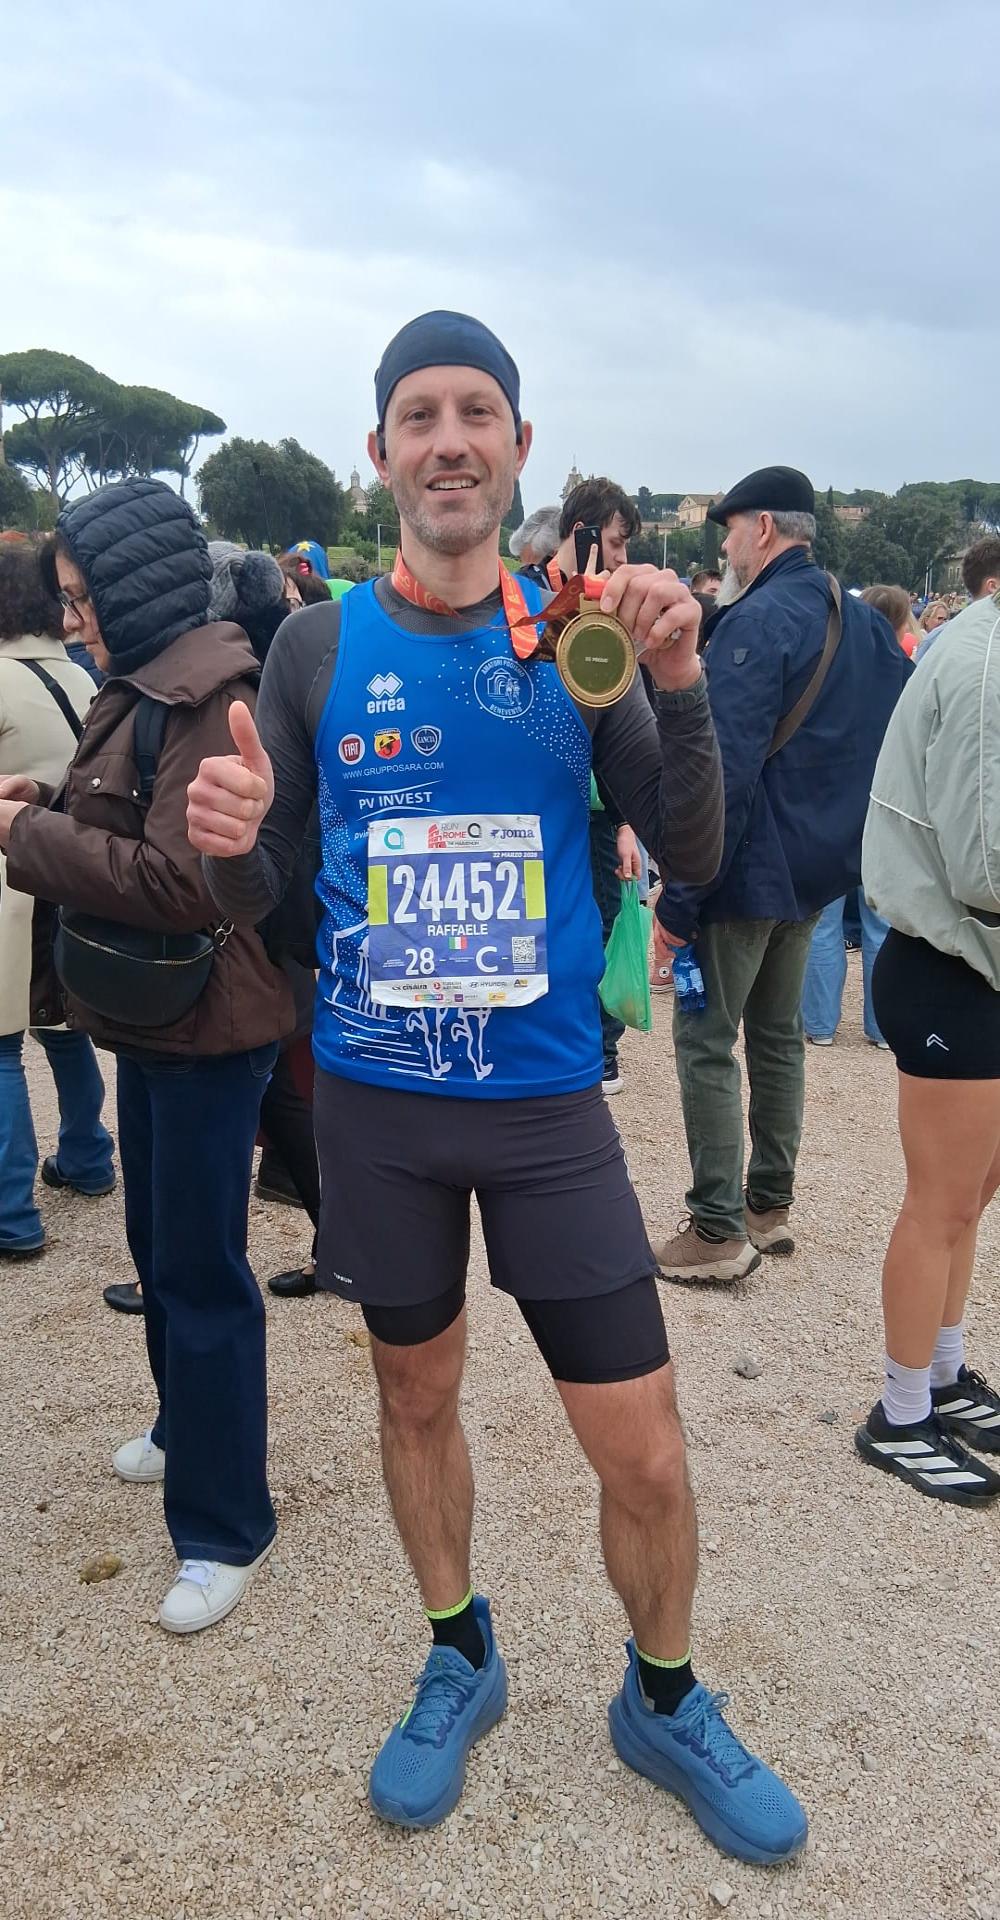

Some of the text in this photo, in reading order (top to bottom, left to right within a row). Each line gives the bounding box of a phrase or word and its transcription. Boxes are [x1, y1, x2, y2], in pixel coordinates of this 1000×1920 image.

[366, 698, 406, 714] errea
[490, 703, 522, 716] BENEVENTO
[417, 736, 436, 744] LANCIA
[344, 742, 359, 758] FIAT
[342, 762, 445, 779] WWW.GRUPPOSARA.COM
[359, 791, 433, 810] PV INVEST
[442, 831, 467, 839] ROME
[392, 861, 521, 924] 24452
[427, 924, 489, 937] RAFFAELE
[405, 946, 499, 976] 28 C
